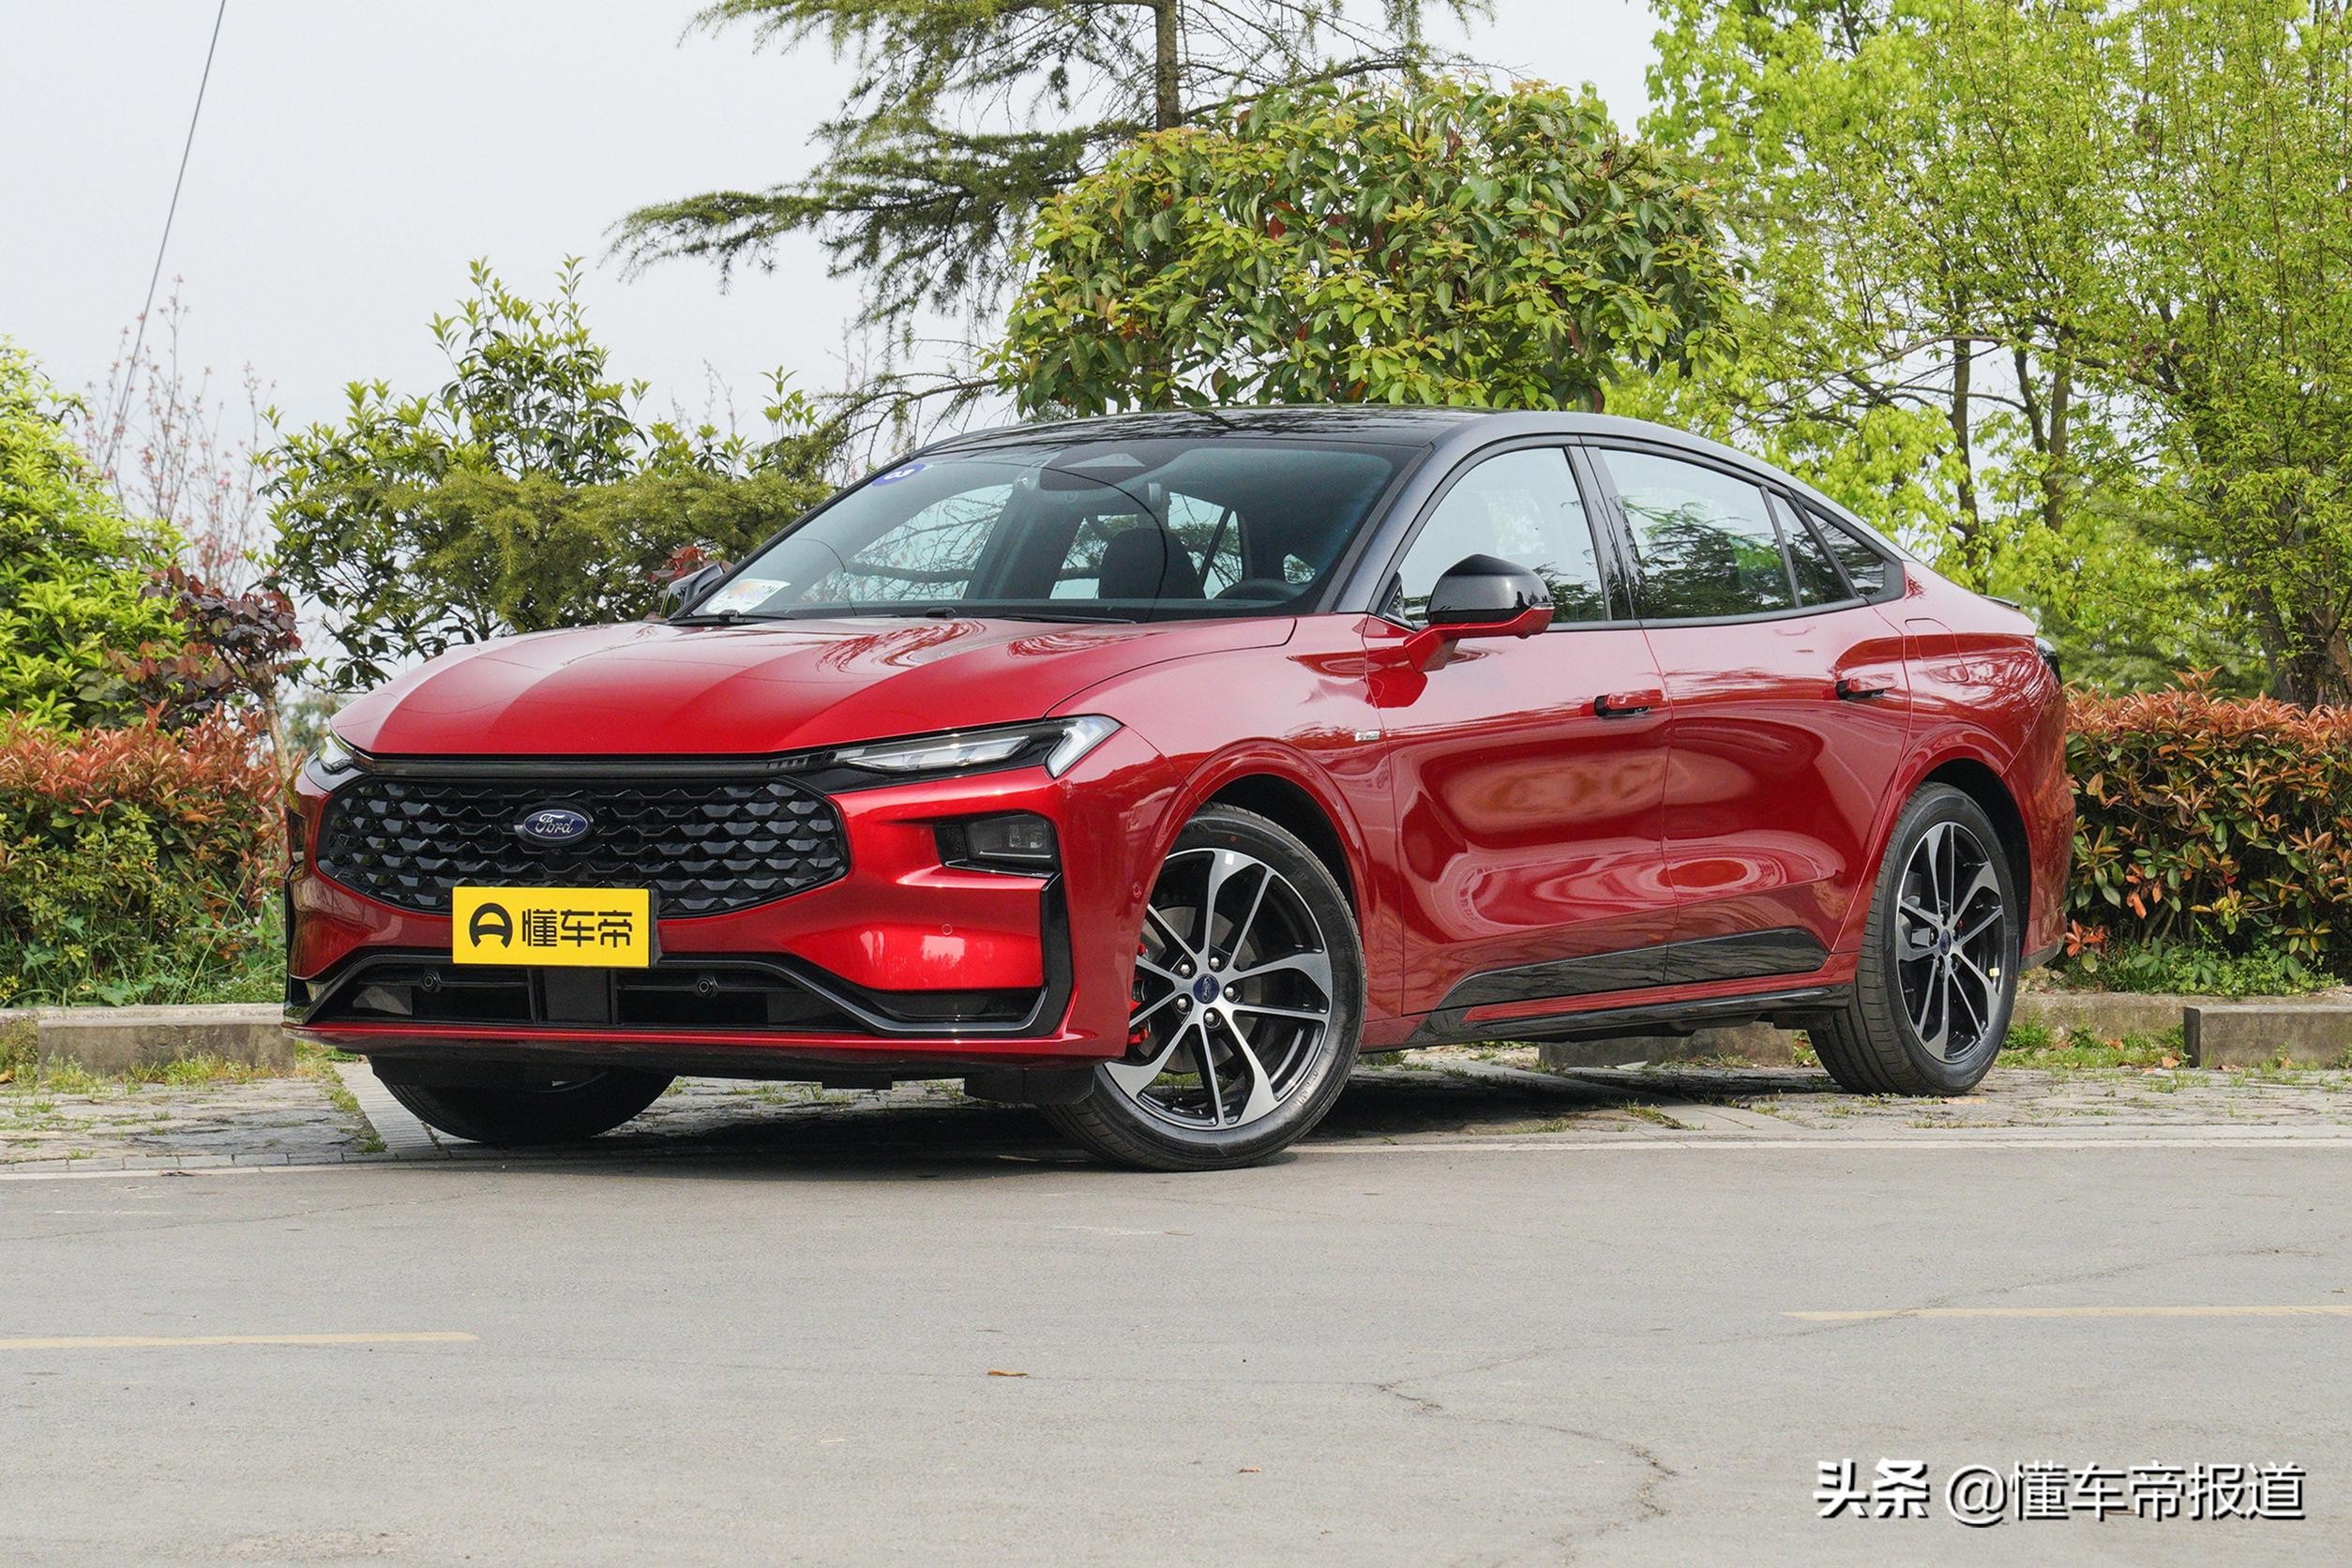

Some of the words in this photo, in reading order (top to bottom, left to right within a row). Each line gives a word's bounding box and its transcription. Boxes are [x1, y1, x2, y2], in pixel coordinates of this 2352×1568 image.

[535, 813, 574, 834] Ford
[521, 909, 633, 948] 懂车帝
